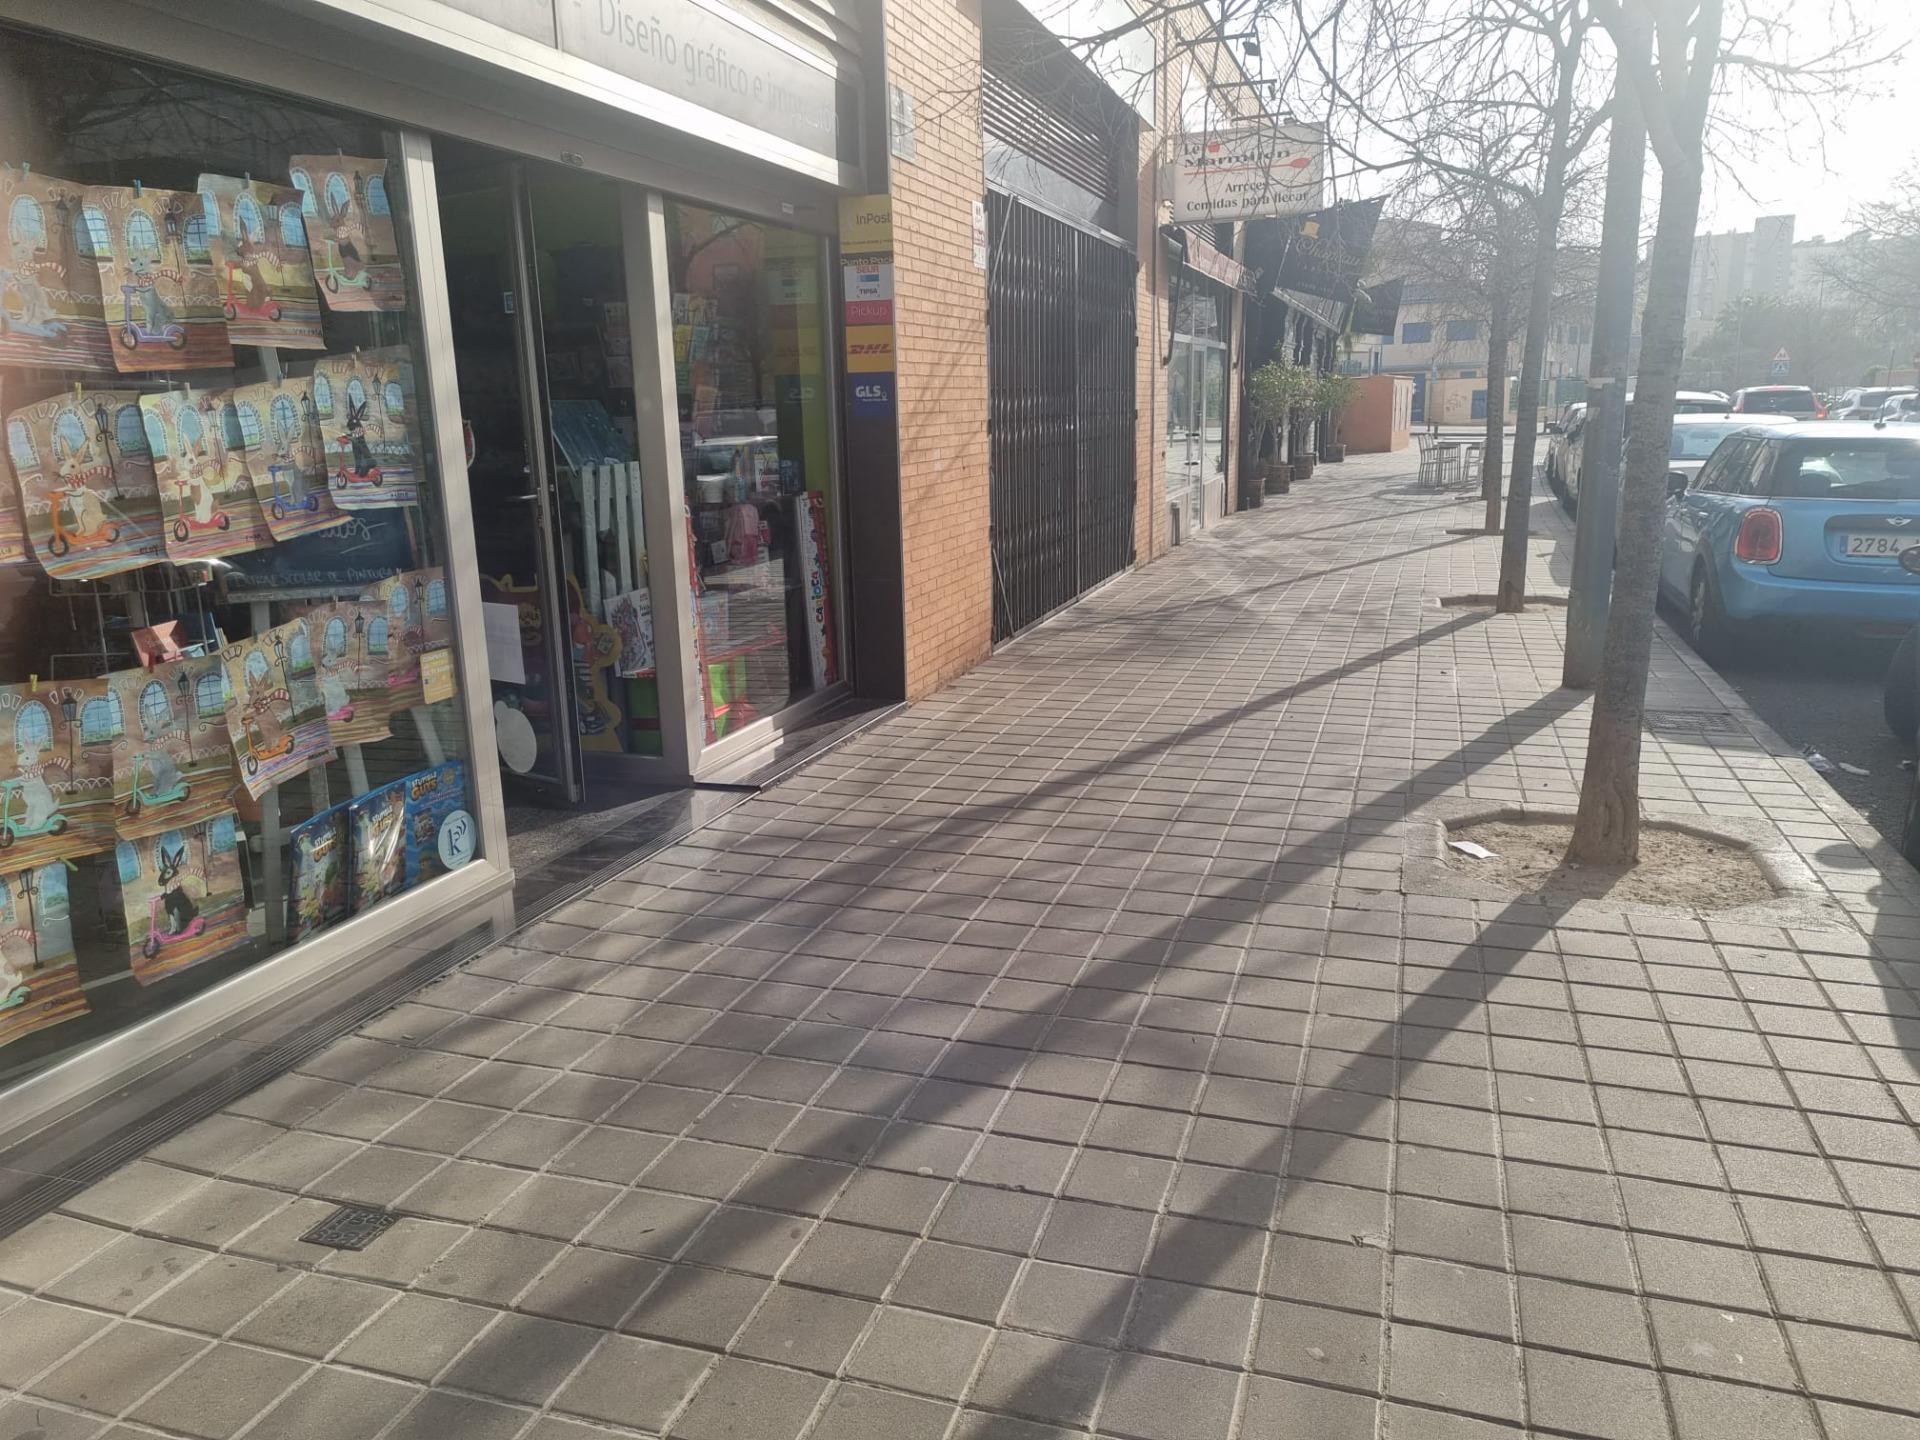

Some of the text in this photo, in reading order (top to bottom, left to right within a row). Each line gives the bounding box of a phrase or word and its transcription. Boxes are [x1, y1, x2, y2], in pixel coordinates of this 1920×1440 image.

[599, 0, 677, 65] Diseño
[684, 43, 748, 96] gráfico
[753, 75, 763, 103] e
[1187, 198, 1238, 212] Comidas
[1242, 195, 1270, 209] para
[856, 212, 891, 225] InPost
[848, 343, 892, 355] DHL
[855, 384, 881, 398] GLS
[1852, 537, 1900, 554] 2784
